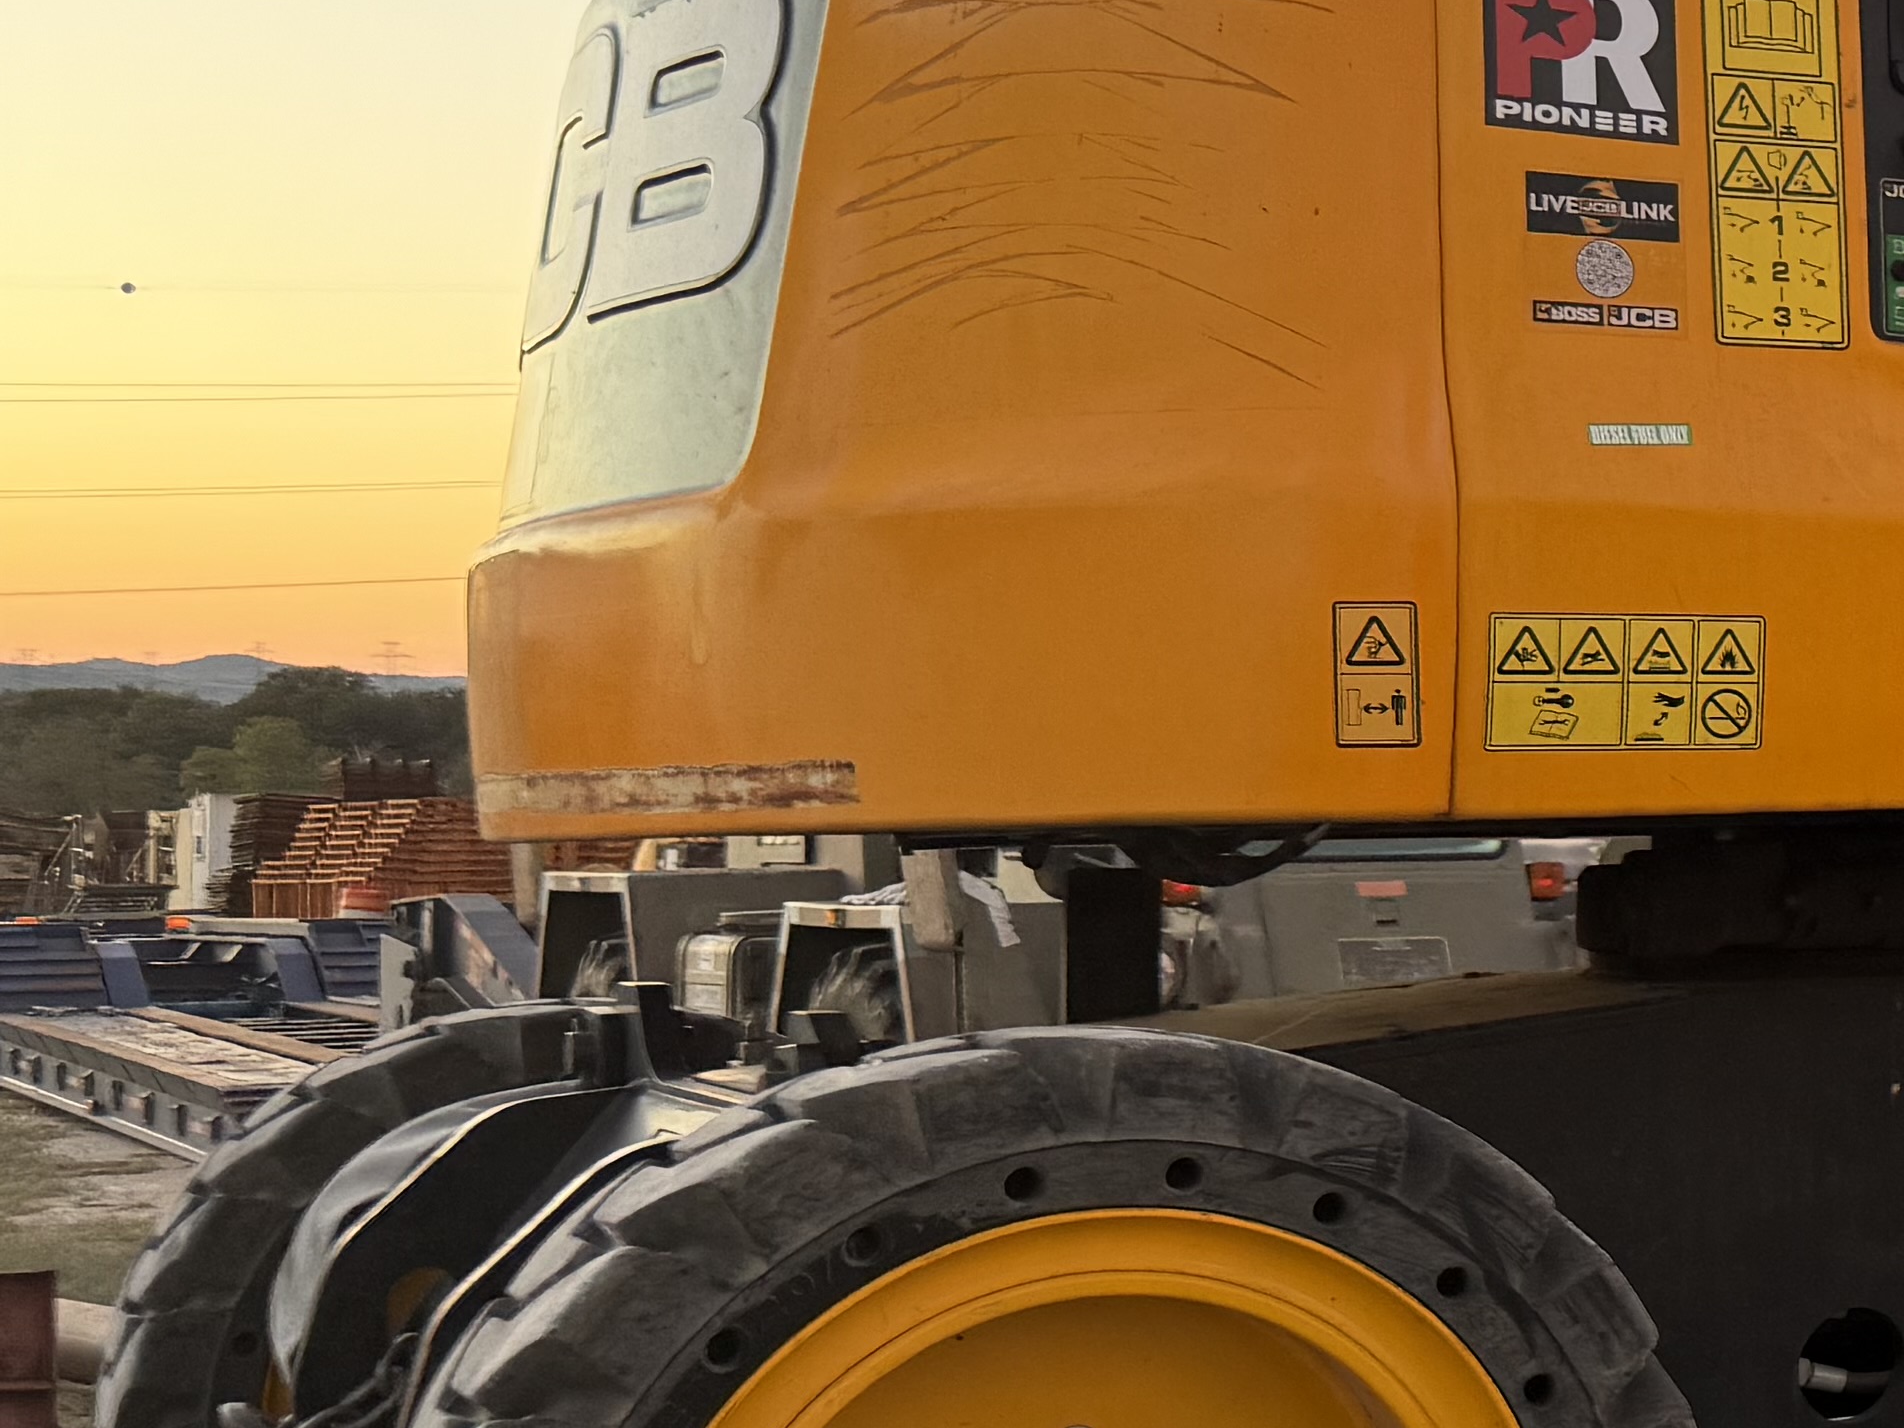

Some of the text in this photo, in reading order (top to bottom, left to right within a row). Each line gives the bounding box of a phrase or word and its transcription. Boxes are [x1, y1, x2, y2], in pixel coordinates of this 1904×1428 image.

[1494, 98, 1669, 137] PIONEER
[1529, 192, 1580, 215] LIVE
[1620, 200, 1676, 222] LINK
[1769, 214, 1784, 236] 1
[1772, 261, 1791, 283] 2
[1551, 303, 1601, 323] BOSS
[1608, 306, 1678, 329] JCB
[1773, 306, 1792, 328] 3
